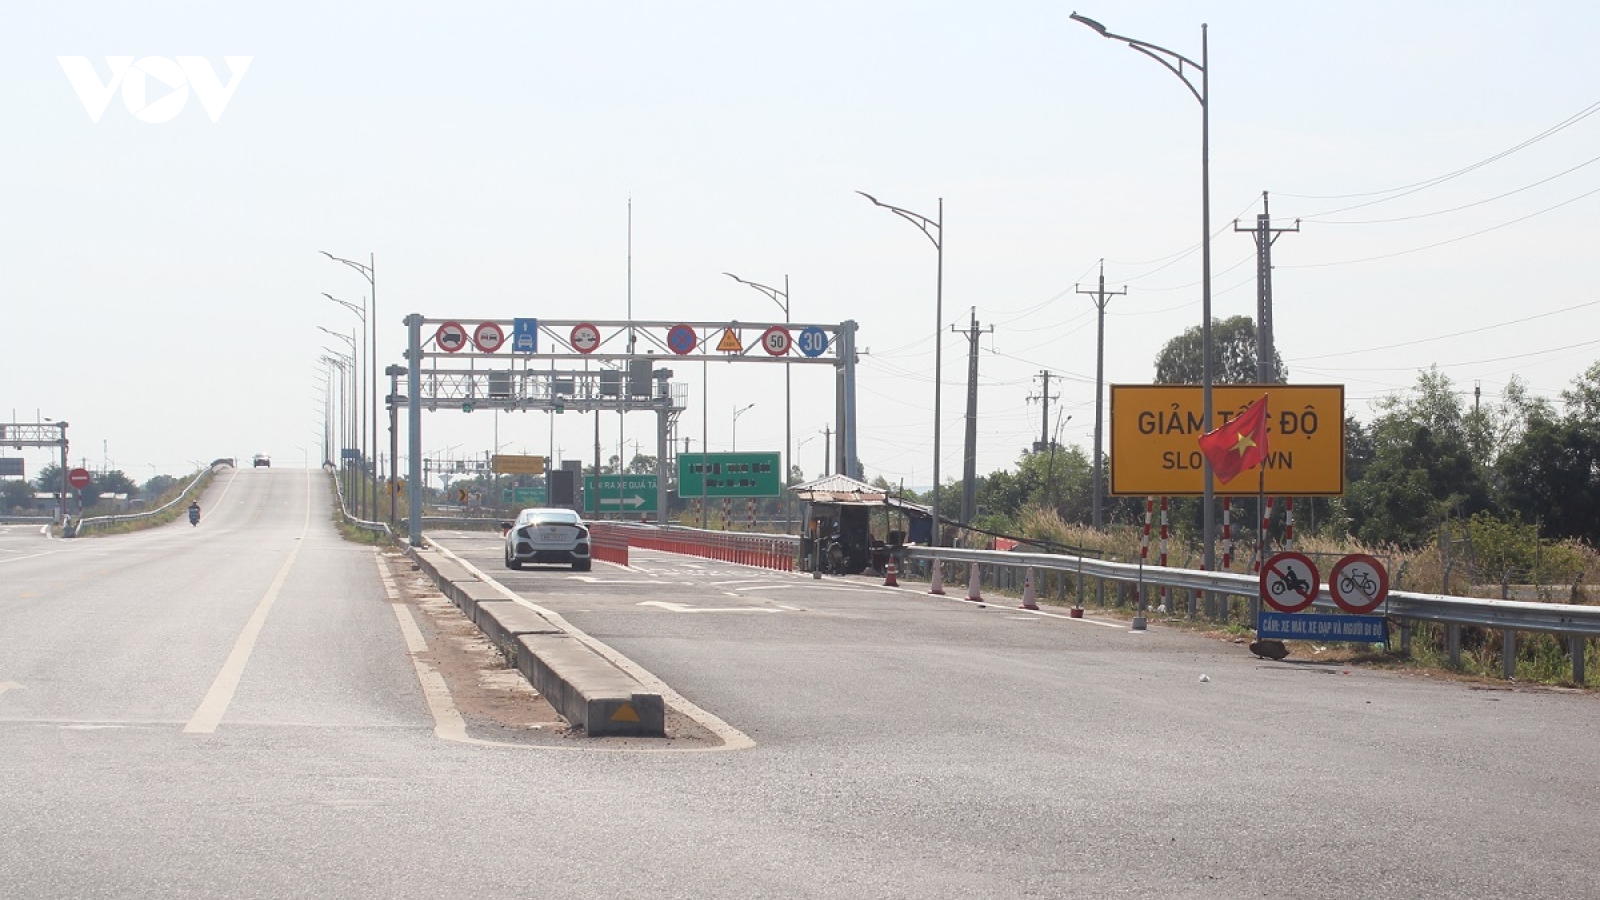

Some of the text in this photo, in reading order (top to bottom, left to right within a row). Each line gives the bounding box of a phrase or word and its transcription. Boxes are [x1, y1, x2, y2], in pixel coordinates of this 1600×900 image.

[771, 335, 784, 348] 50
[804, 332, 822, 351] 30
[1138, 402, 1204, 435] GIẢM
[1279, 404, 1318, 440] ĐỘ
[1162, 451, 1203, 470] SLO
[604, 481, 616, 490] RA
[629, 478, 646, 490] QUÁ
[1281, 620, 1290, 632] XE
[1308, 621, 1317, 634] XE
[1318, 621, 1332, 637] ĐẠP
[1332, 620, 1342, 635] VÀ
[1372, 621, 1382, 639] BỘ
